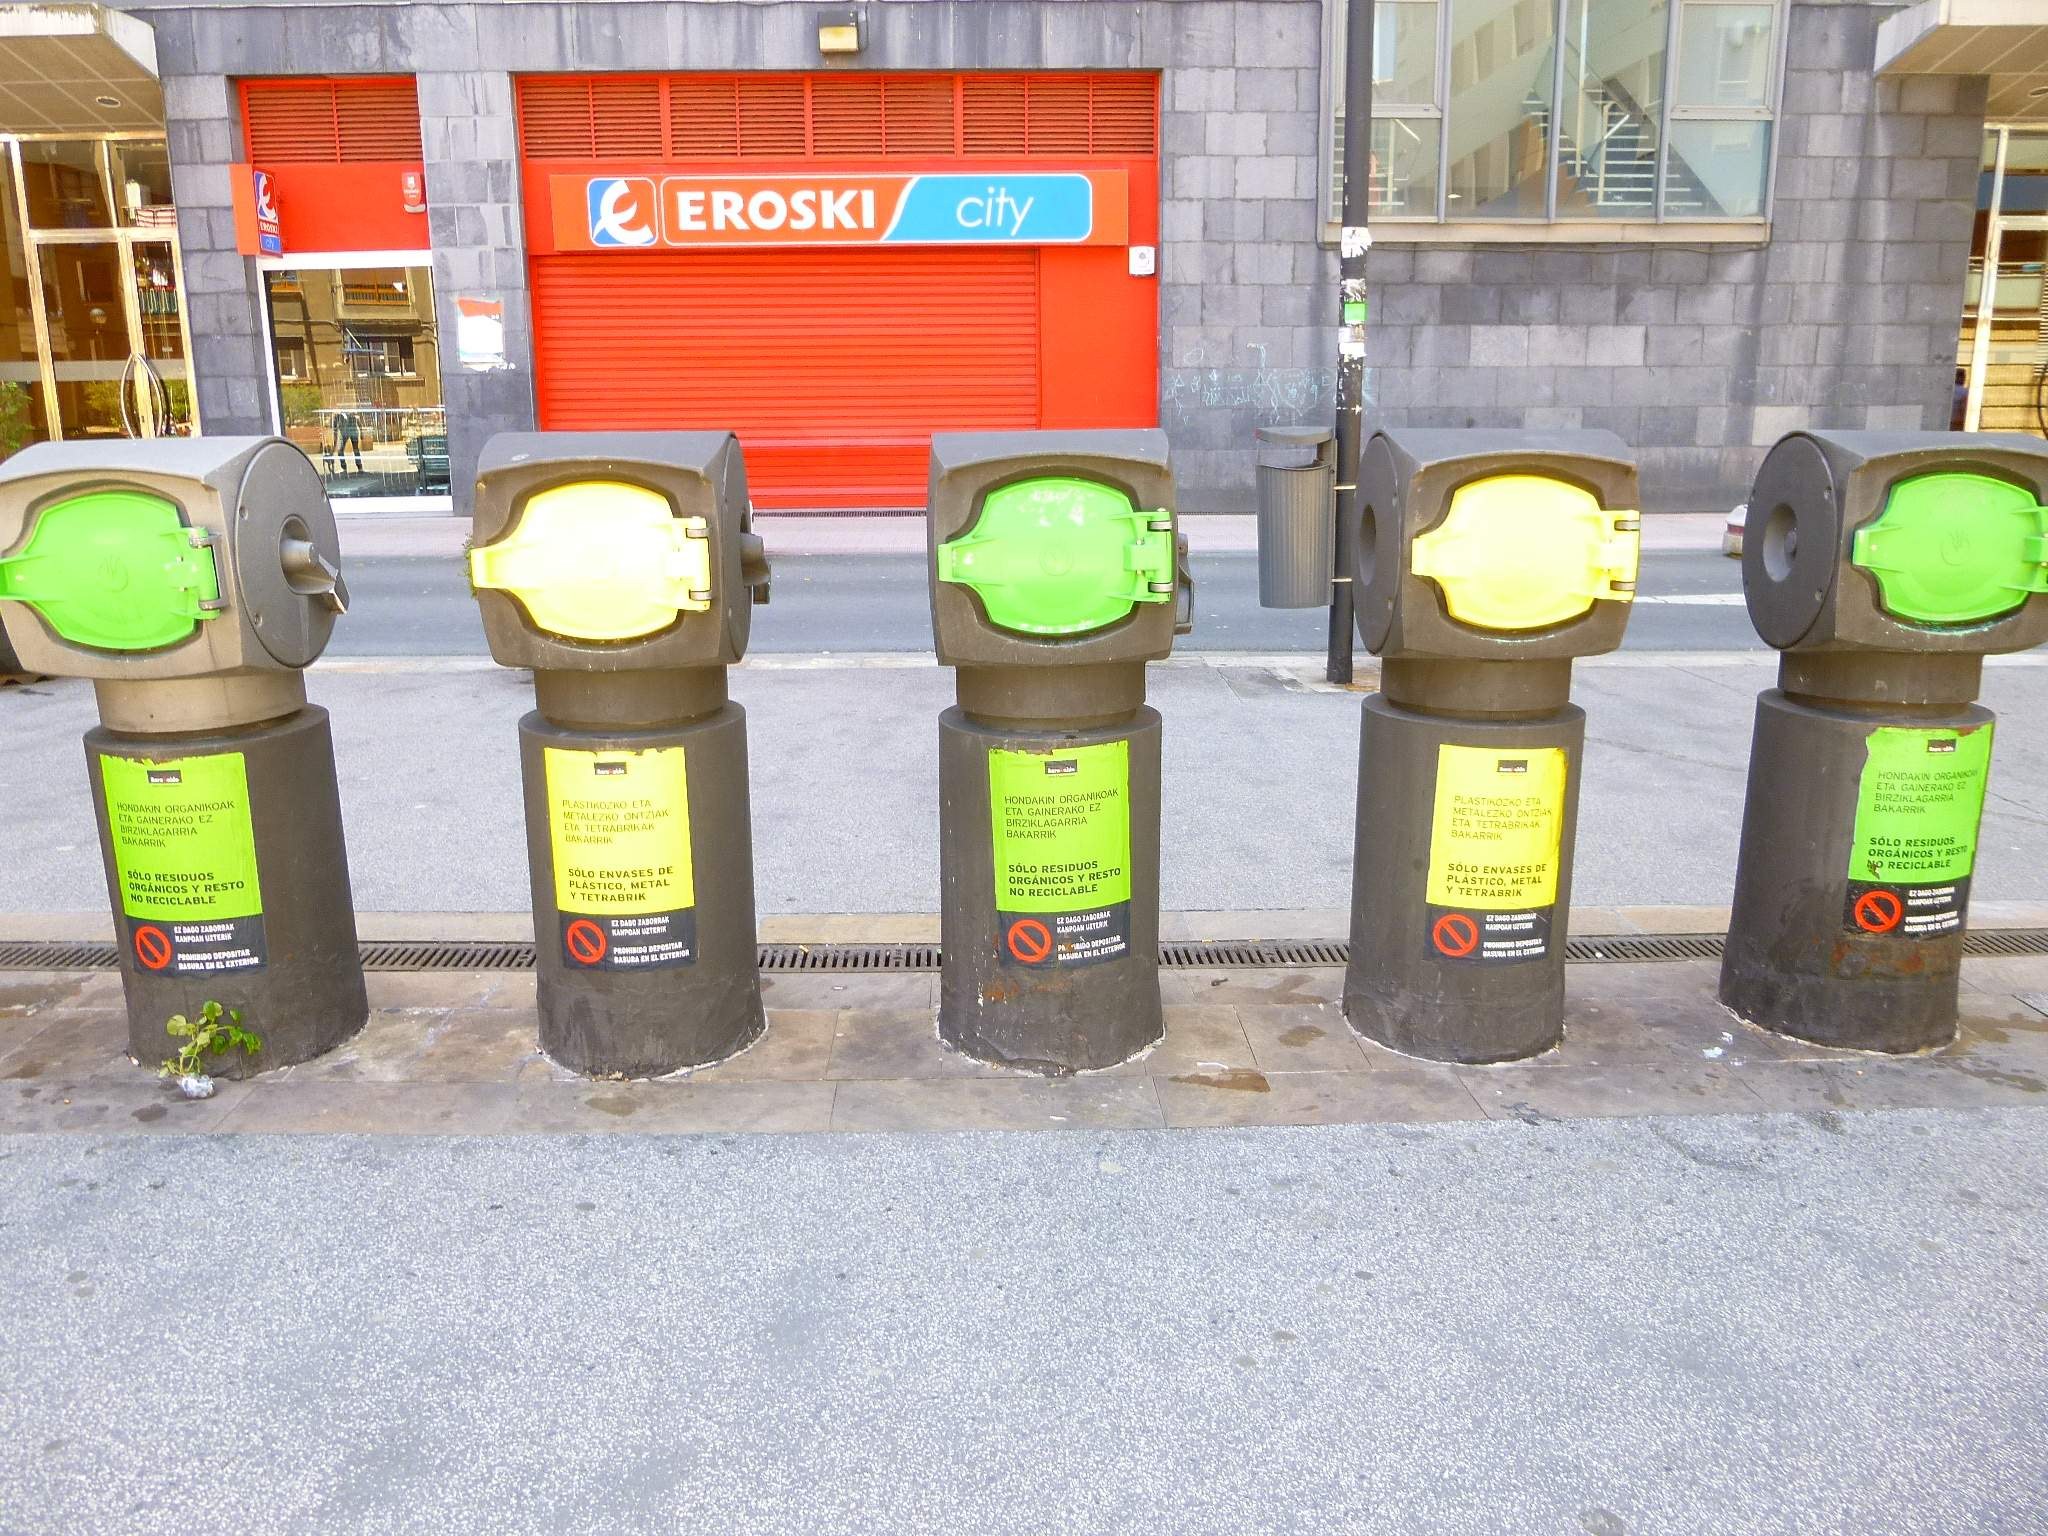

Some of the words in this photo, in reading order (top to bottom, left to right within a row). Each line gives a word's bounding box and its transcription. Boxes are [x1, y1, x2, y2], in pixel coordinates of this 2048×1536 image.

[677, 190, 875, 231] EROSKI
[956, 187, 1033, 237] city
[1879, 771, 1930, 780] HONDAKIN
[1877, 783, 1895, 791] ETA
[1901, 783, 1953, 791] GAINERAKO
[1005, 796, 1055, 804] HONDAKIN
[1060, 788, 1118, 803] ORGANIKOAK
[1876, 794, 1953, 803] BIRZIKLAGARRIA
[117, 802, 160, 814] HONDAKIN
[165, 800, 235, 813] ORGANIKOAK
[562, 800, 626, 809] PLASTIKOZKO
[633, 800, 651, 808] ETA
[1006, 807, 1023, 816] ETA
[1028, 806, 1084, 816] GAINERAKO
[1089, 803, 1101, 811] EZ
[1874, 804, 1926, 814] BAKARRIK
[119, 814, 133, 823] ETA
[137, 816, 193, 824] GAINERAKO
[199, 815, 213, 823] EZ
[563, 811, 619, 821] METALEZKO
[624, 810, 670, 820] ONTZIAK
[1006, 816, 1088, 827] BIRZIKLAGARRIA
[1453, 818, 1470, 827] ETA
[121, 826, 197, 836] BIRZIKLAGARRIA
[564, 823, 580, 831] ETA
[585, 823, 654, 832] TETRABRIKAK
[566, 834, 613, 844] BAKARRIK
[1007, 830, 1056, 838] BAKARRIK
[1451, 830, 1502, 840] BAKARRIK
[122, 837, 166, 847] BAKARRIK
[1870, 836, 1900, 847] SÓLO
[1906, 837, 1955, 847] RESIDUOS
[1868, 848, 1933, 858] ORGÁNICOS
[1009, 863, 1037, 873] SÓLO
[1042, 861, 1098, 873] RESIDUOS
[1448, 862, 1478, 873] SÓLO
[1484, 865, 1532, 873] ENVASES
[1536, 864, 1547, 872] DE
[1888, 860, 1951, 870] RECICLABLE
[128, 869, 150, 881] SÓLO
[155, 873, 214, 882] RESIDUOS
[569, 867, 595, 878] SÓLO
[600, 869, 653, 878] ENVASES
[658, 866, 674, 875] DE
[1009, 874, 1073, 884] ORGÁNICOS
[1078, 874, 1085, 882] Y
[1089, 868, 1120, 881] RESTO
[569, 879, 626, 890] PLÁSTICO,
[631, 878, 670, 888] METAL
[1447, 873, 1506, 886] PLÁSTICO,
[1511, 876, 1542, 885] METAL
[130, 881, 187, 893] ORGÁNICOS
[205, 881, 244, 891] RESTO
[1010, 888, 1024, 896] NO
[1029, 884, 1098, 896] RECICLABLE
[571, 892, 576, 900] Y
[580, 892, 646, 902] TETRABRIK
[1460, 888, 1522, 897] TETRABRIK
[131, 895, 143, 903] NO
[146, 896, 216, 905] RECICLABLE
[213, 949, 250, 959] DEPOSITAR
[660, 949, 689, 960] EXTERIOR
[226, 957, 258, 967] EXTERIOR
